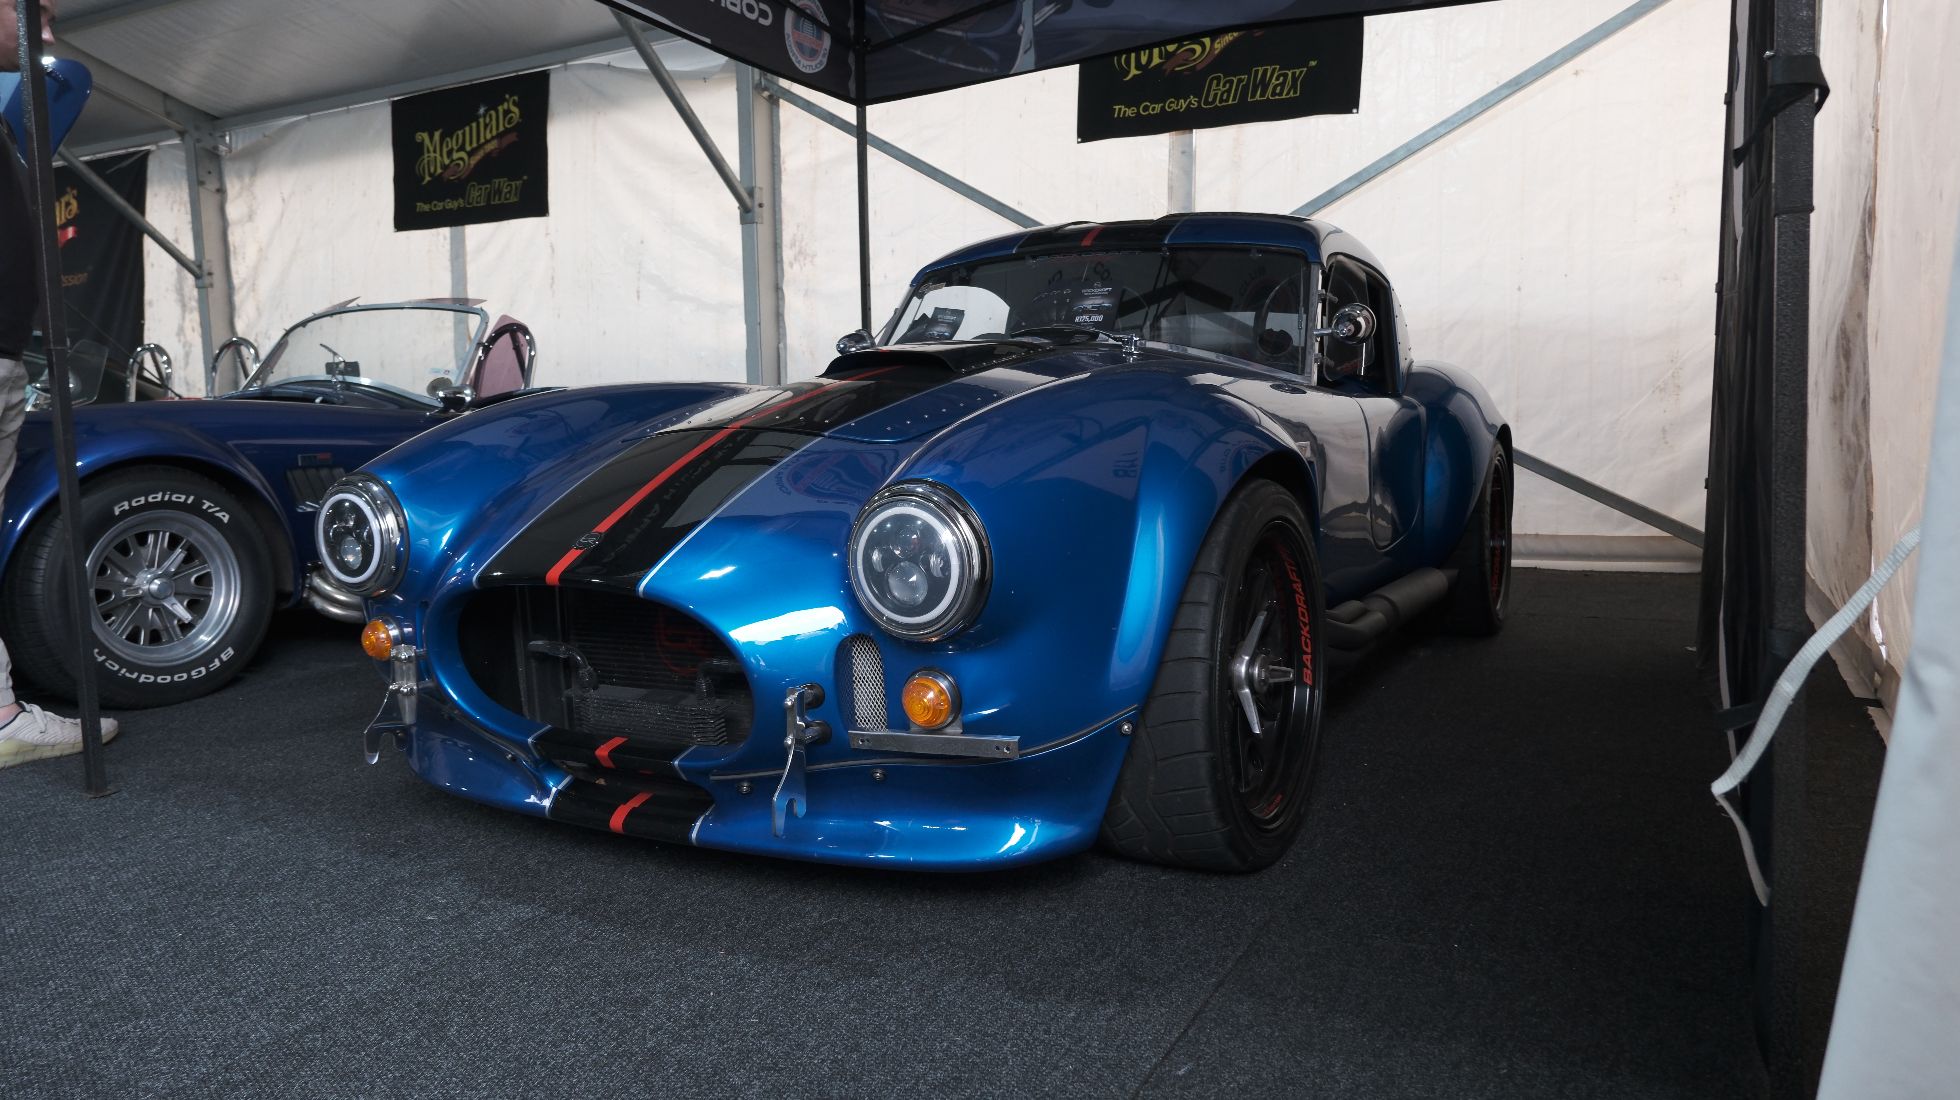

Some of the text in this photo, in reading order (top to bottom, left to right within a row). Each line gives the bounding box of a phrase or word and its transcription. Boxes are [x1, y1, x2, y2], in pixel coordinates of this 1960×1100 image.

[1113, 105, 1137, 118] The
[1139, 102, 1163, 115] Car
[1165, 95, 1199, 113] Guy's
[1201, 73, 1247, 108] Car
[415, 94, 521, 185] Meguiar's
[465, 182, 490, 207] Car
[113, 491, 231, 524] Radial T/A
[1284, 555, 1313, 686] BACKDRAFT
[93, 646, 235, 684] BFGoodrich
